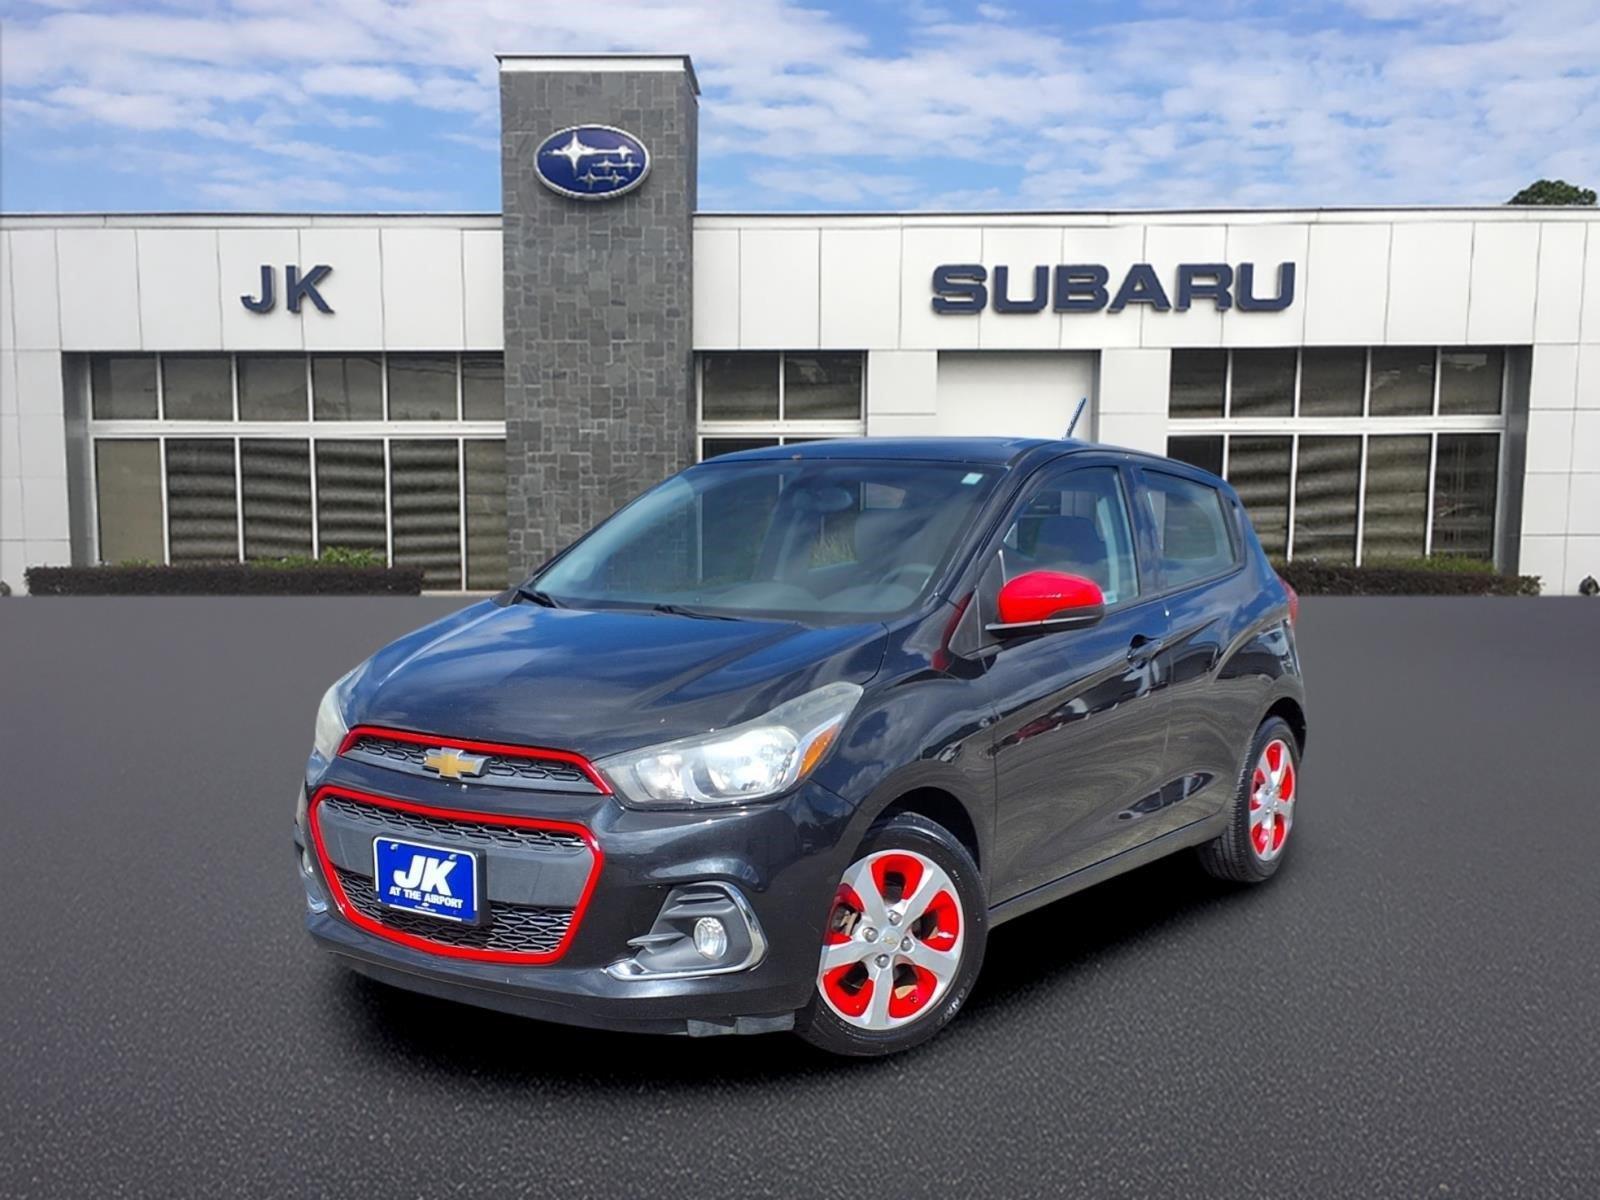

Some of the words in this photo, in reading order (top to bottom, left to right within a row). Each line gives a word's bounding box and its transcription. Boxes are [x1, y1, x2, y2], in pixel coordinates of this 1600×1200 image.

[240, 265, 335, 314] JK
[932, 262, 1296, 315] SUBARU
[389, 886, 401, 896] AT
[404, 889, 421, 900] THE
[424, 894, 463, 909] AIRPORT
[393, 855, 457, 897] JK
